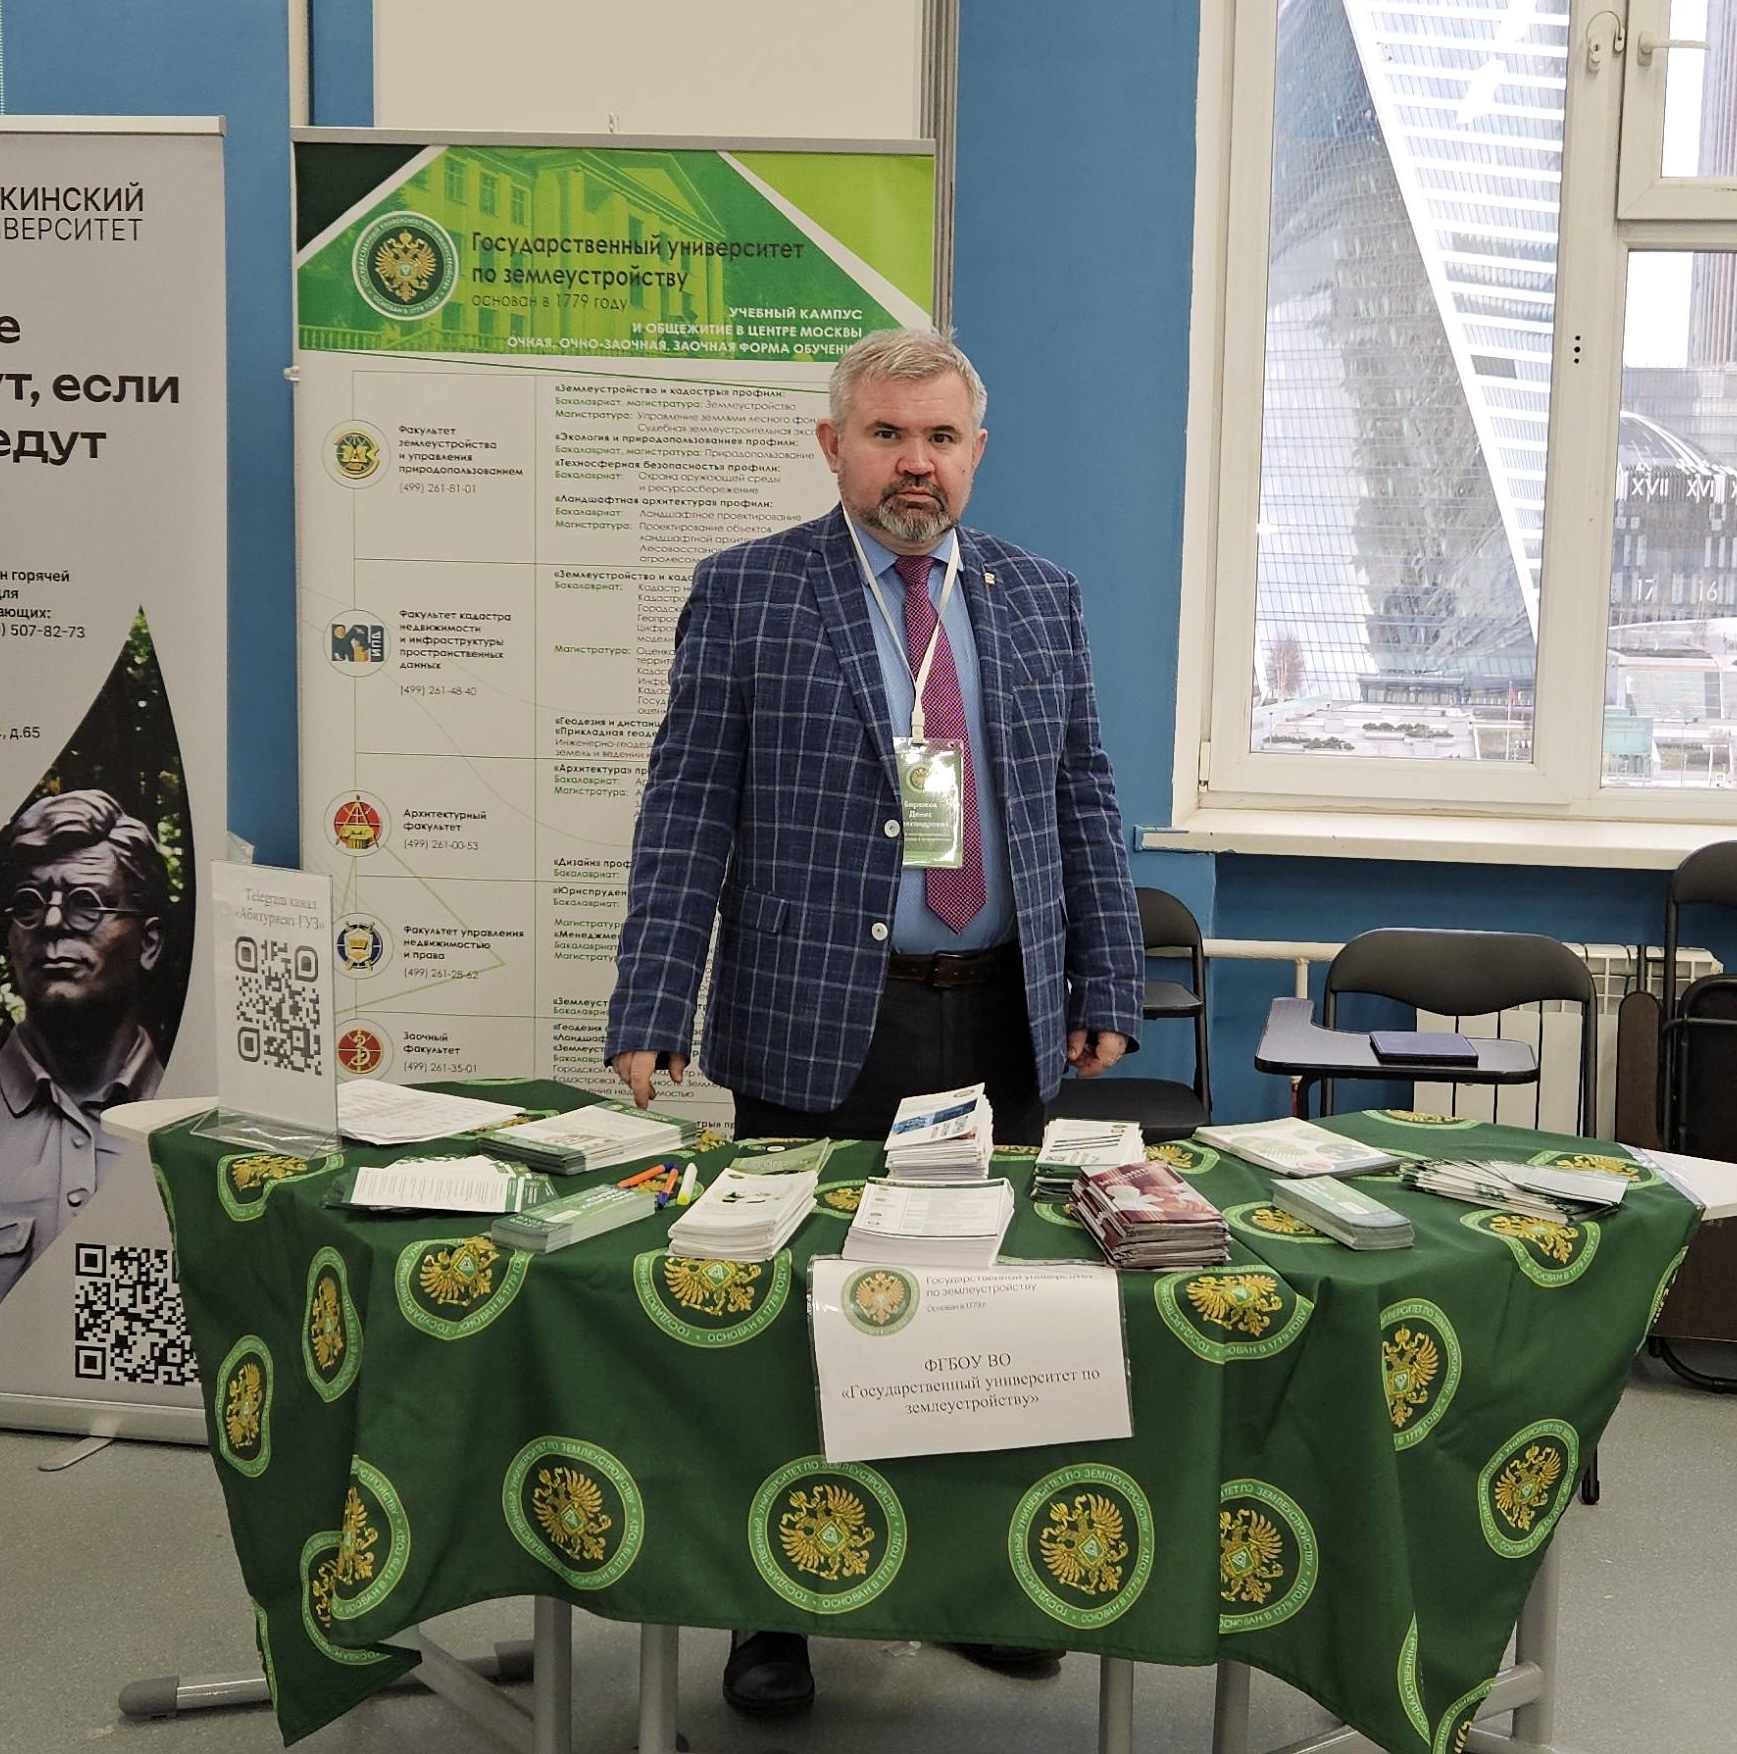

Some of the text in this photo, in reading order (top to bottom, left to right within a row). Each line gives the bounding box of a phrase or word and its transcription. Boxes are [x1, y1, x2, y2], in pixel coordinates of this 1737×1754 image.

[0, 181, 144, 212] КИНСКИЙ
[471, 231, 805, 262] Государственный университет
[472, 265, 688, 292] по землеустройству
[471, 293, 628, 312] основан в 1779 году
[729, 306, 863, 320] УЧЕБНЫЙ КАМПУС
[632, 322, 862, 338] И ОБЩЕЖИТИЕ В ЦЕНТРЕ МОСКВЫ
[673, 340, 735, 353] ЗАОЧНАЯ
[738, 342, 790, 354] ФОРМА
[0, 373, 180, 407] т, если
[555, 383, 657, 395] «Землеустройство
[733, 389, 785, 398] профили:
[705, 400, 796, 411] Землеустройство
[398, 425, 456, 436] Факультет
[398, 439, 497, 450] землеустройства
[555, 432, 609, 442] «Экология
[746, 438, 798, 447] профили:
[408, 453, 473, 463] управления
[398, 466, 524, 477] природопользованием
[555, 458, 640, 468] «Техносферная
[728, 464, 781, 473] профили:
[399, 482, 425, 495] (499)
[1631, 477, 1669, 497] XVII
[555, 494, 639, 505] «Ландшафтная
[720, 499, 773, 508] профили:
[12, 570, 70, 584] горячей
[1637, 579, 1717, 601] 17 16
[399, 609, 512, 622] Факультет кадастра
[10, 624, 86, 639] 507-82-73
[399, 623, 481, 634] недвижимости
[409, 636, 504, 648] инфраструктуры
[399, 648, 504, 660] пространственных
[399, 660, 442, 670] данных
[399, 685, 425, 697] (499)
[555, 717, 606, 727] «Геодезия
[9, 726, 41, 740] д.65
[555, 727, 624, 737] «Прикладная
[554, 764, 632, 775] «Архитектура»
[554, 786, 629, 797] Магистратура:
[403, 808, 487, 821] Архитектурный
[403, 822, 461, 832] факультет
[403, 839, 479, 851] (499) 261-00-53
[403, 925, 525, 939] Факультет управления
[403, 938, 491, 950] недвижимостью
[413, 951, 445, 962] права
[403, 967, 429, 979] (499)
[403, 1031, 448, 1042] Заочный
[403, 1044, 460, 1055] факультет
[403, 1061, 478, 1074] (499) 261-35-01
[926, 1290, 940, 1298] по
[924, 1352, 1012, 1373] ФГБОУ ВО
[841, 1369, 1101, 1401] «Государственный университет по
[904, 1392, 1040, 1415] землеустройству»
[804, 1460, 819, 1470] ПО
[1065, 1470, 1081, 1480] ПО
[822, 1588, 872, 1608] ОСНОВАН
[877, 1559, 896, 1582] 1779
